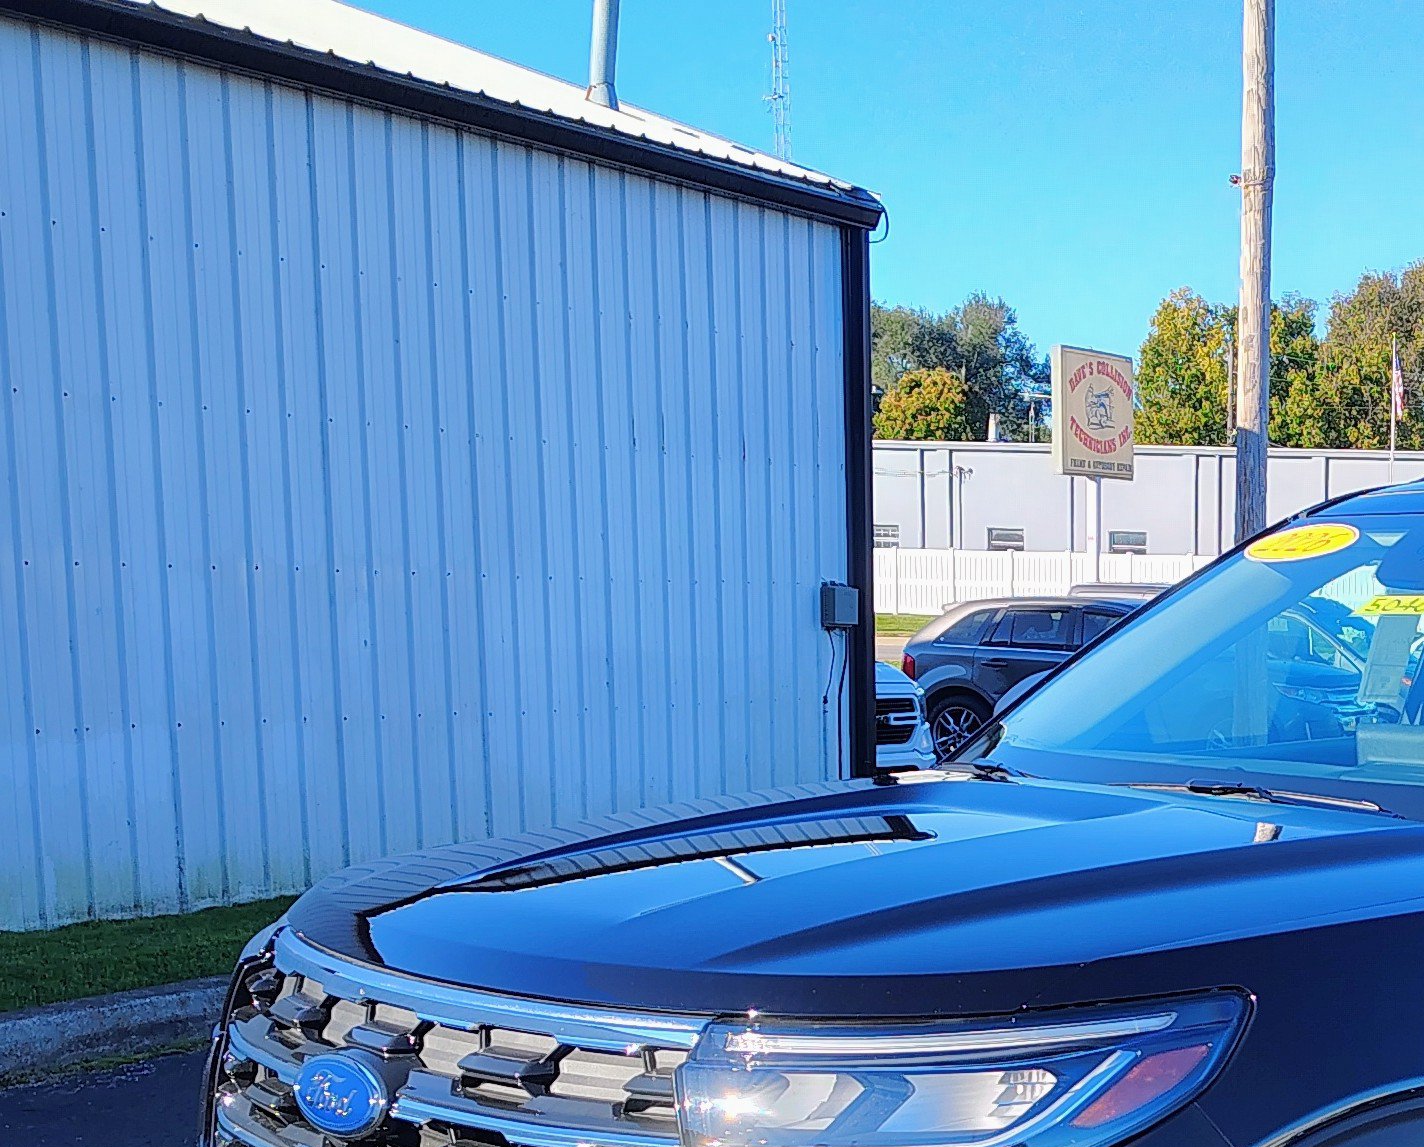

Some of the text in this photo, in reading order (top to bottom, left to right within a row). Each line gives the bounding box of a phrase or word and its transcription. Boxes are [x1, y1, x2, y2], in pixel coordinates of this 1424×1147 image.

[1069, 360, 1133, 401] DAVE'S COLLISION
[1070, 415, 1132, 454] TECHNICIANS INC.
[305, 1069, 358, 1117] Ford
